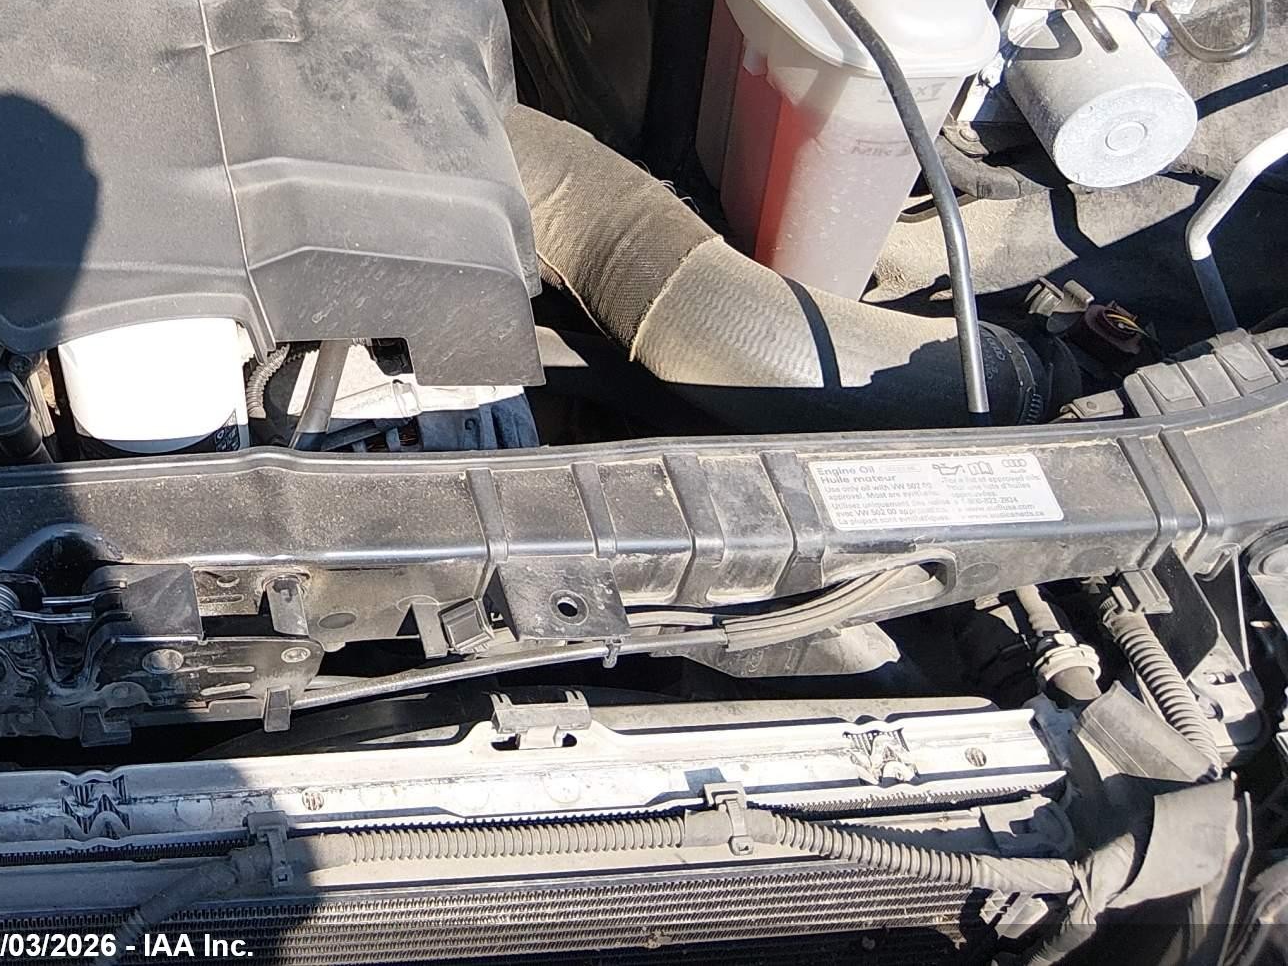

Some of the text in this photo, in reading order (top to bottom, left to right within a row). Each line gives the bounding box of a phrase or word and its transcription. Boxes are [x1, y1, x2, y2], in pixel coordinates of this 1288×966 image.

[816, 467, 857, 476] Engine
[859, 465, 876, 474] Oil
[820, 475, 851, 484] Huile
[825, 485, 841, 493] Use
[841, 485, 859, 494] only
[860, 484, 872, 492] oil
[873, 483, 890, 491] with
[892, 482, 905, 490] VW
[906, 481, 920, 489] 502
[866, 491, 887, 499] Most
[854, 509, 869, 517] VW
[870, 508, 885, 516] 502
